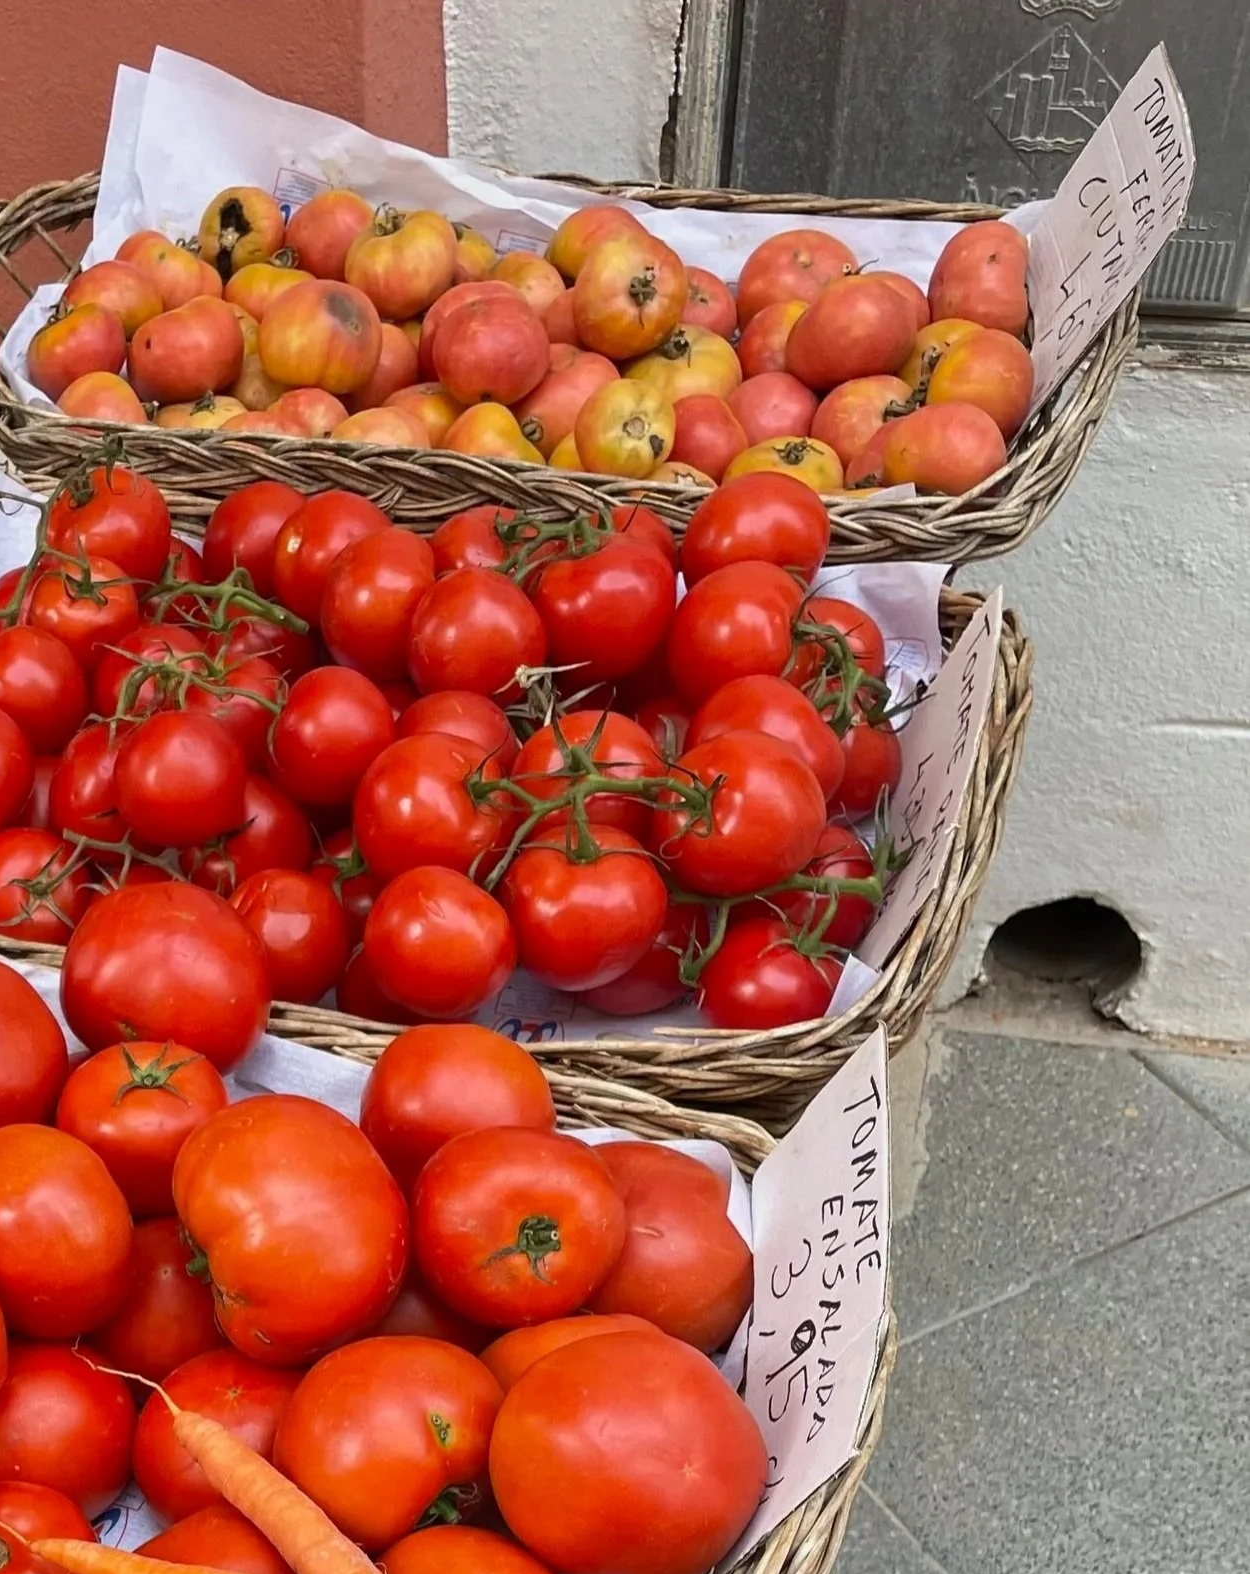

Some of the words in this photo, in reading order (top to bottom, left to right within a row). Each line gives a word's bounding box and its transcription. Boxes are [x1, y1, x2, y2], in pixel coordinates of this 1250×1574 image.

[947, 613, 990, 774] TOMATE
[844, 1075, 881, 1285] TOMATE
[759, 1238, 816, 1422] 3,95
[807, 1195, 845, 1444] ENSALADA
